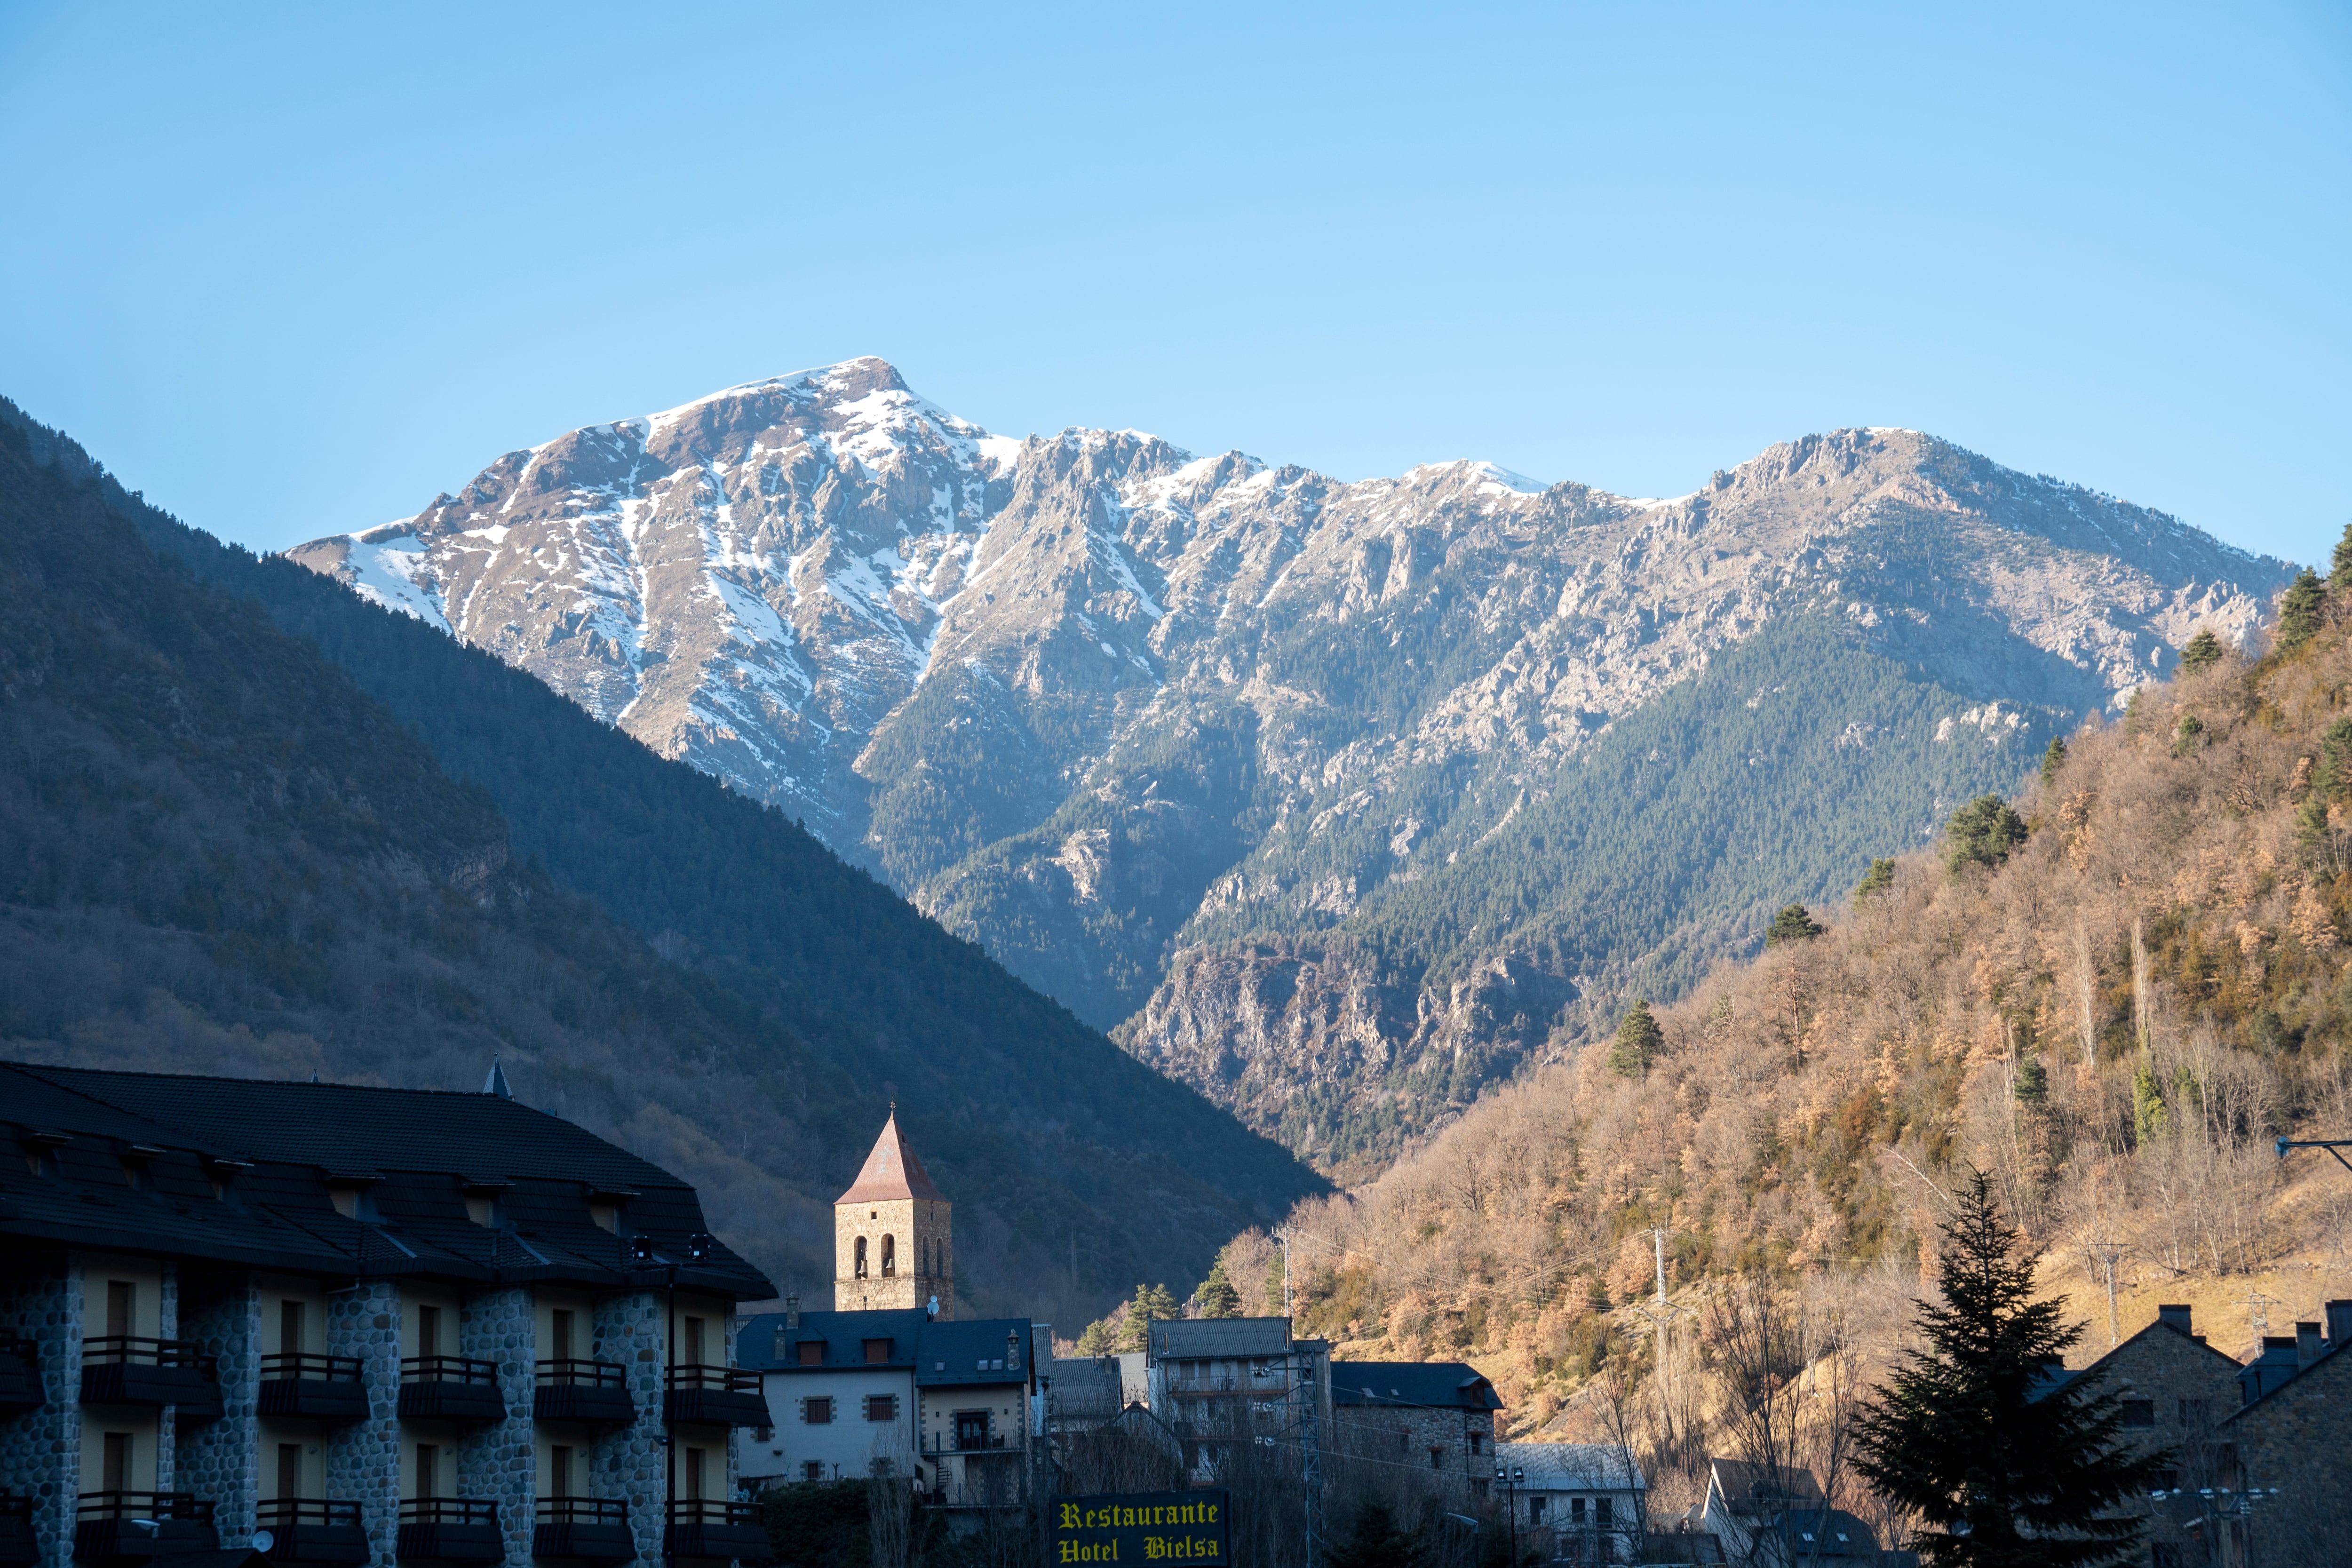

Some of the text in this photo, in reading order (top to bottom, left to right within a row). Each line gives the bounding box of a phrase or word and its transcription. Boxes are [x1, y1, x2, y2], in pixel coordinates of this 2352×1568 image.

[1058, 1501, 1218, 1529] Restaurante
[1058, 1535, 1218, 1563] Hotel Bielsa
